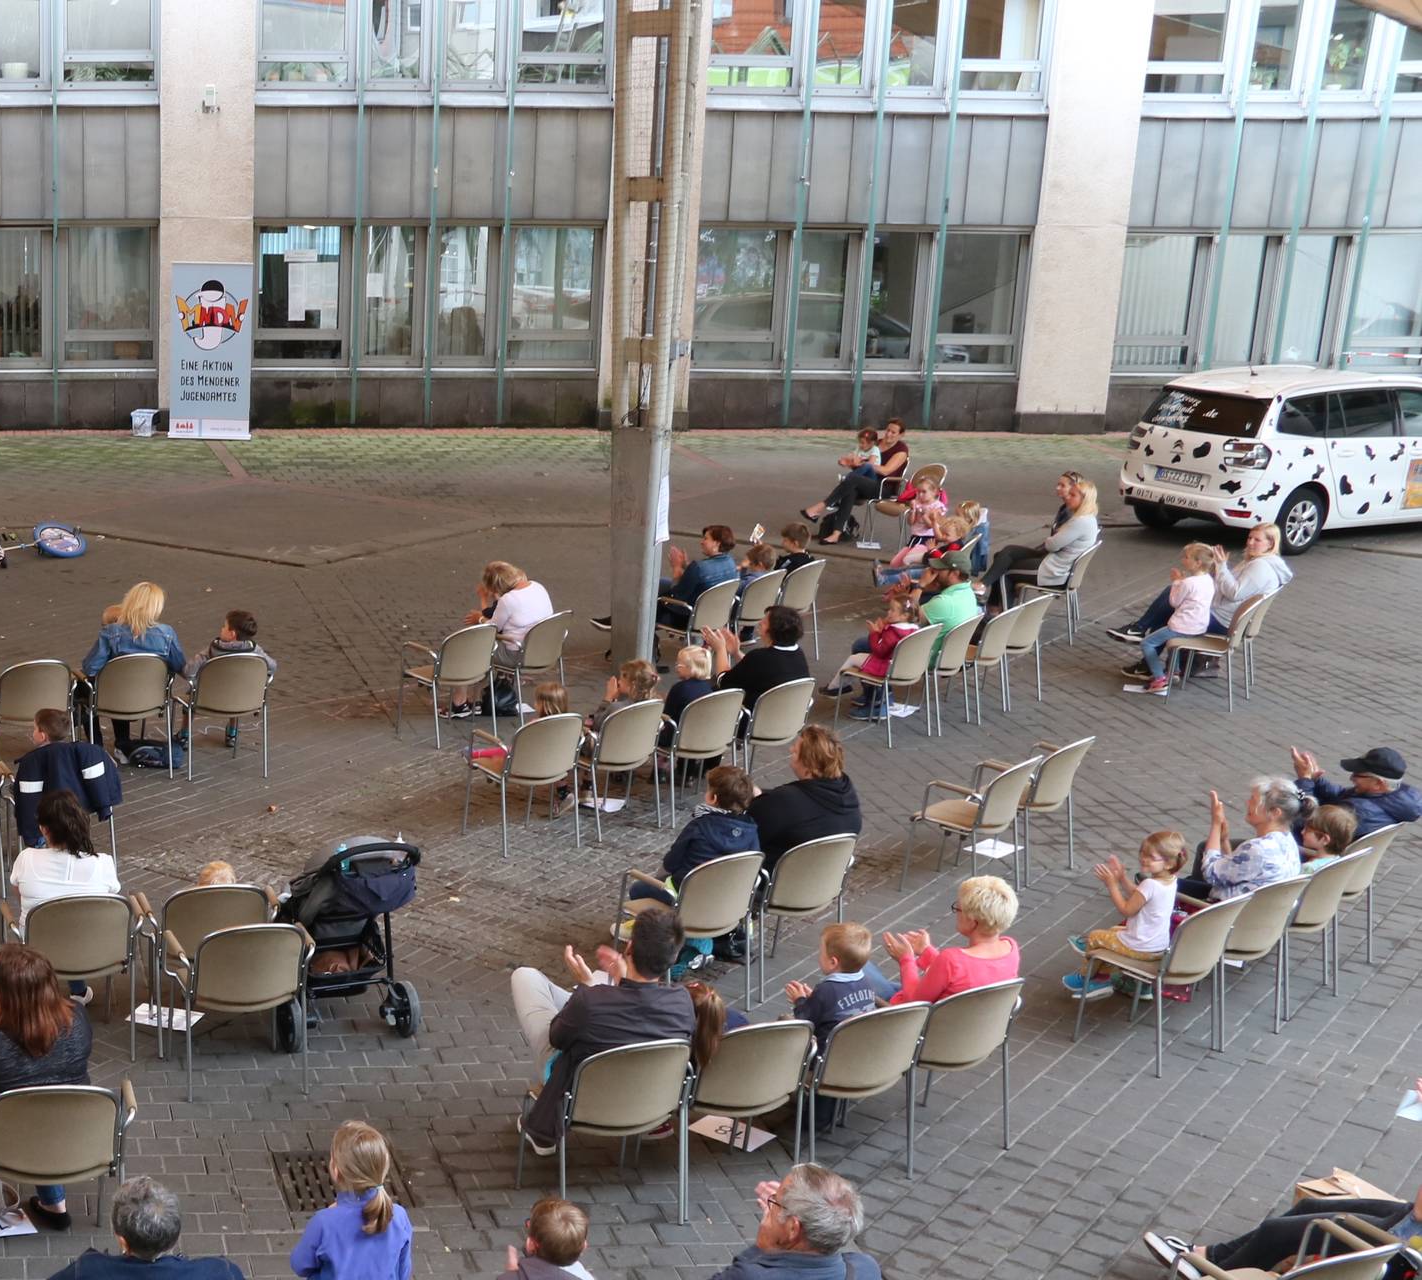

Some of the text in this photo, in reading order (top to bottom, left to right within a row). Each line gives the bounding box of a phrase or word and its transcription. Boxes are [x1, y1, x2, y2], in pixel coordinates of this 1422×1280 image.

[180, 359, 233, 371] EINE AKTION
[180, 375, 240, 387] DES MENDENER
[180, 390, 237, 402] JUGENDAMTES
[1202, 409, 1219, 419] .de
[1136, 487, 1153, 499] 0171
[1177, 497, 1187, 506] 99
